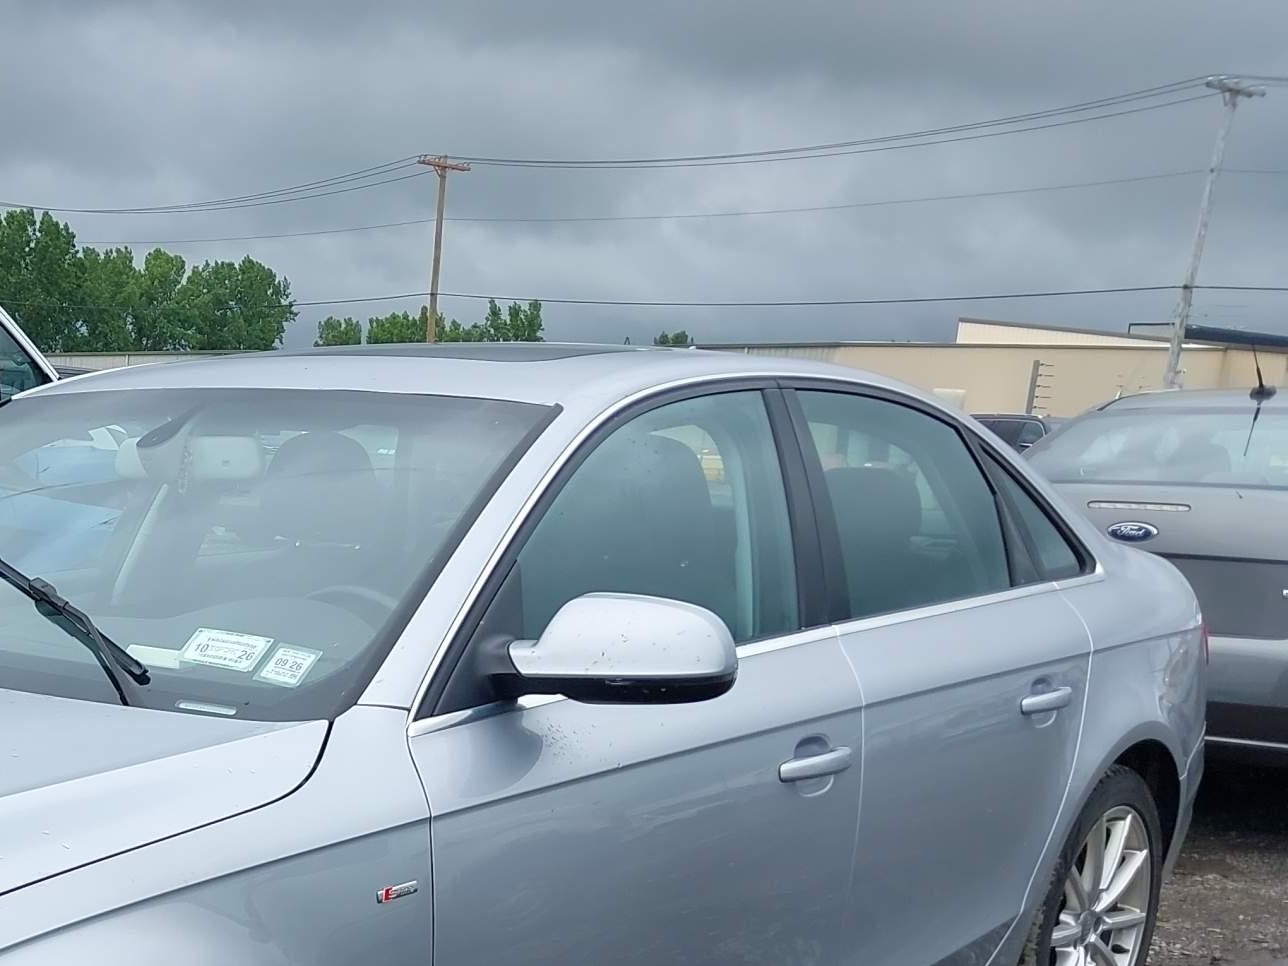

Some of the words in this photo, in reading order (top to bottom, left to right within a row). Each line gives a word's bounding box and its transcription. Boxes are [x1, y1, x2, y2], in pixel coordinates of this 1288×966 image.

[1116, 525, 1146, 537] Ford
[194, 643, 210, 653] 10
[237, 649, 255, 661] 26
[274, 657, 289, 667] 09
[289, 660, 304, 671] 26
